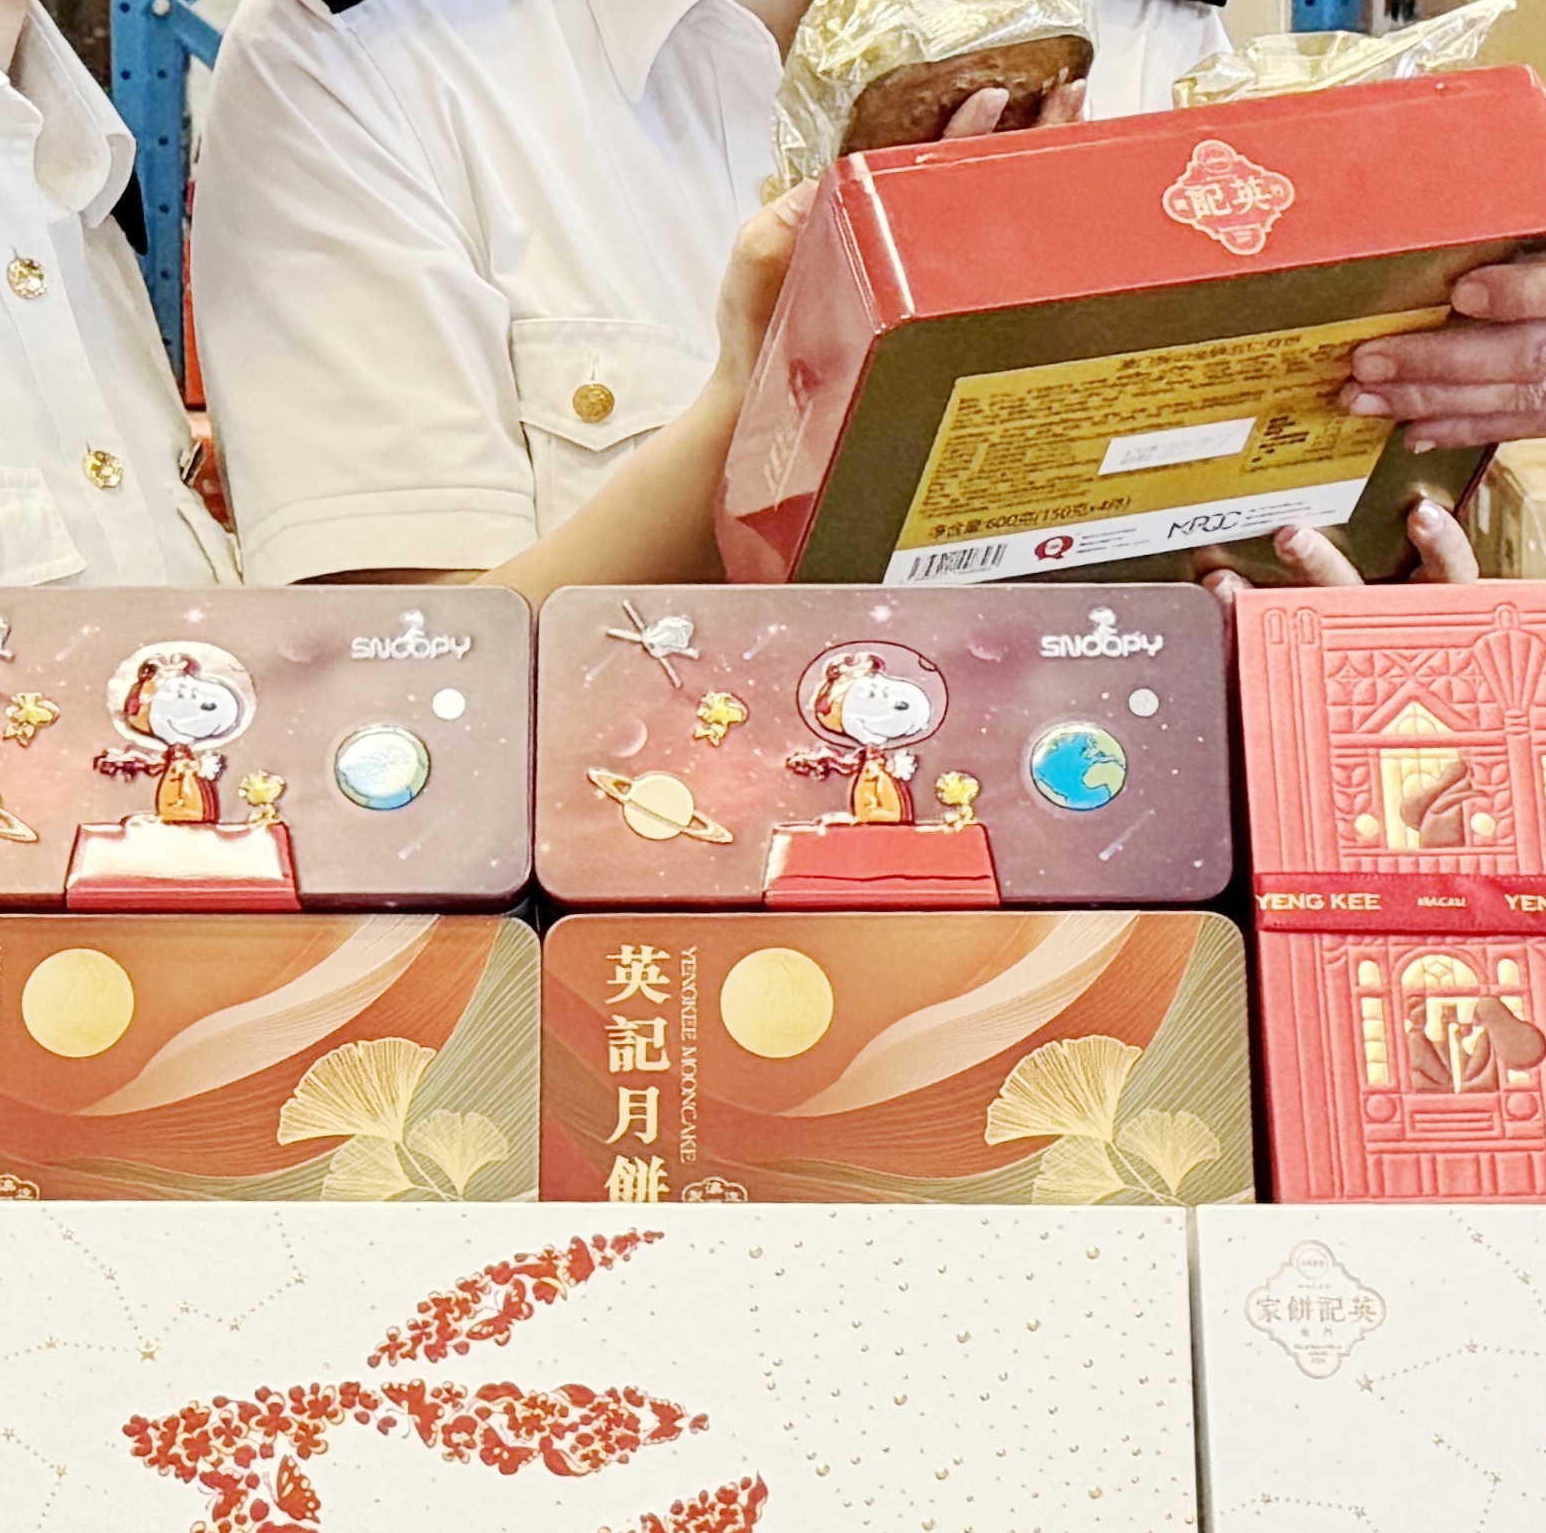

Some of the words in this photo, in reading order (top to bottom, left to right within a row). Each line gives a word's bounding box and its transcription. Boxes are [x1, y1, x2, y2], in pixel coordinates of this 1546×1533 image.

[350, 635, 472, 661] SNOOPY
[1040, 634, 1164, 658] SNOOPY
[1255, 893, 1326, 912] YENG
[1331, 893, 1381, 911] KEE
